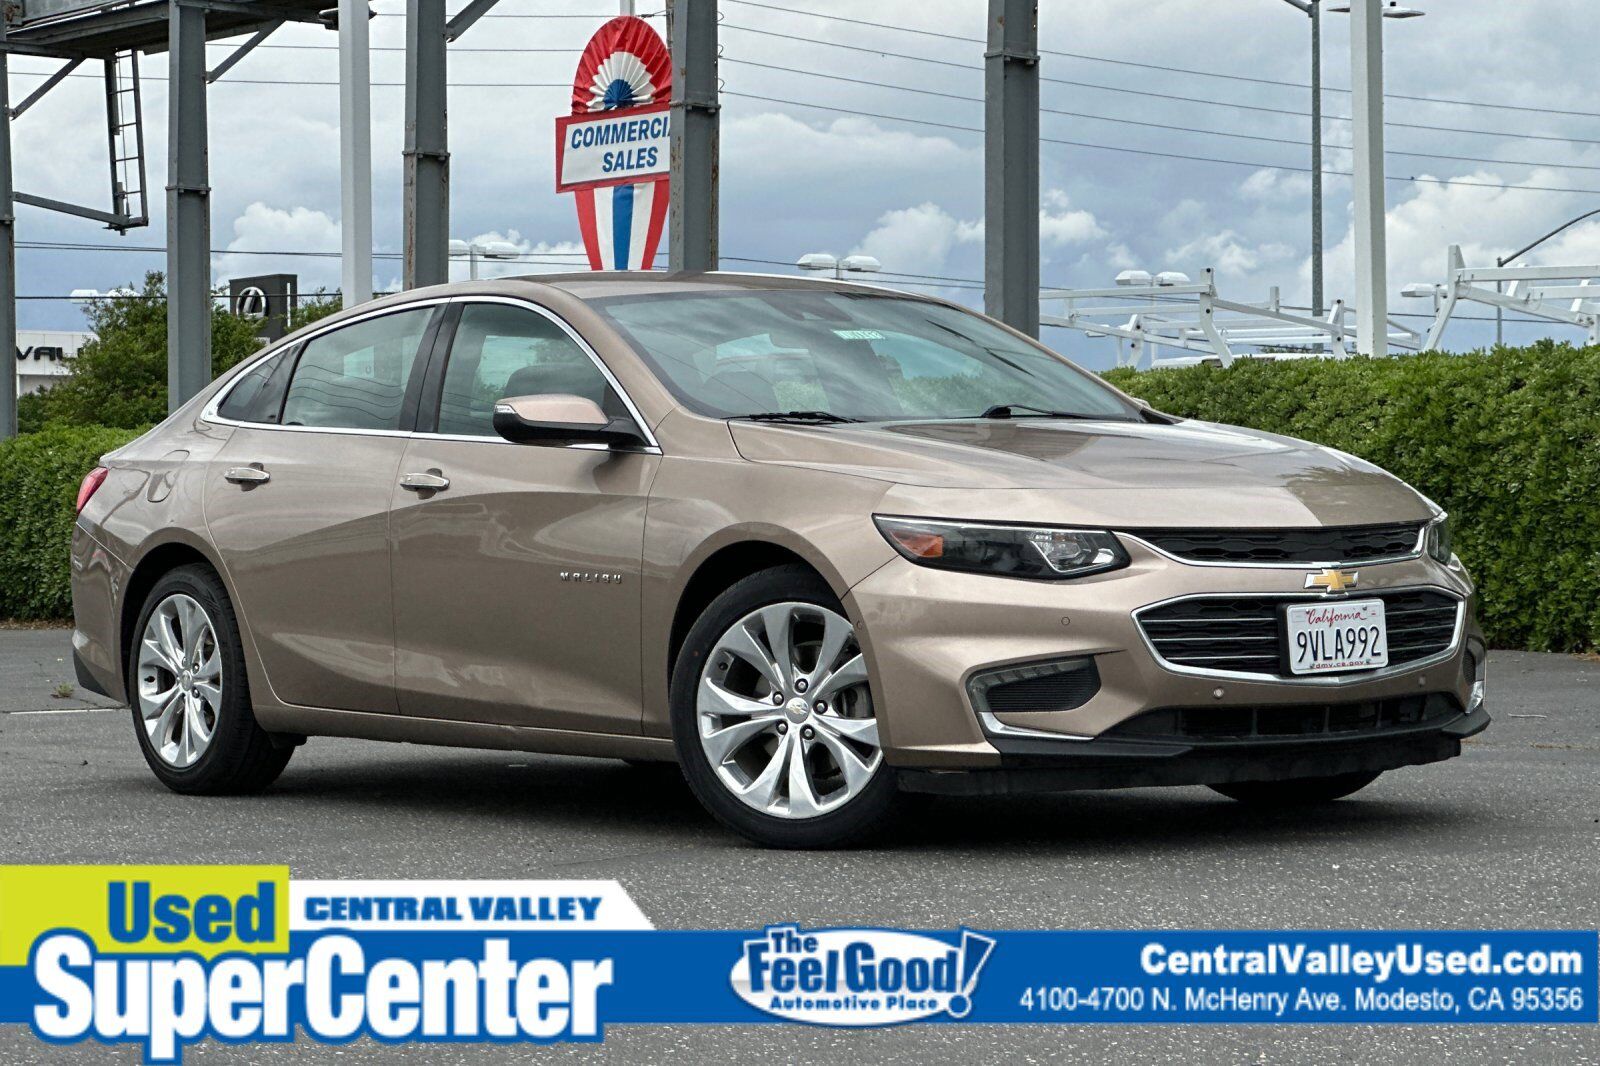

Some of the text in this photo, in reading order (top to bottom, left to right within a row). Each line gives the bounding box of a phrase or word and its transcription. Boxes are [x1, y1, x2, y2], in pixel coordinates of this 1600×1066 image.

[571, 116, 670, 149] COMMERCI
[602, 146, 658, 172] SALES
[560, 572, 622, 584] MALIBU
[1306, 608, 1367, 628] California
[1296, 625, 1382, 663] 9VLA992
